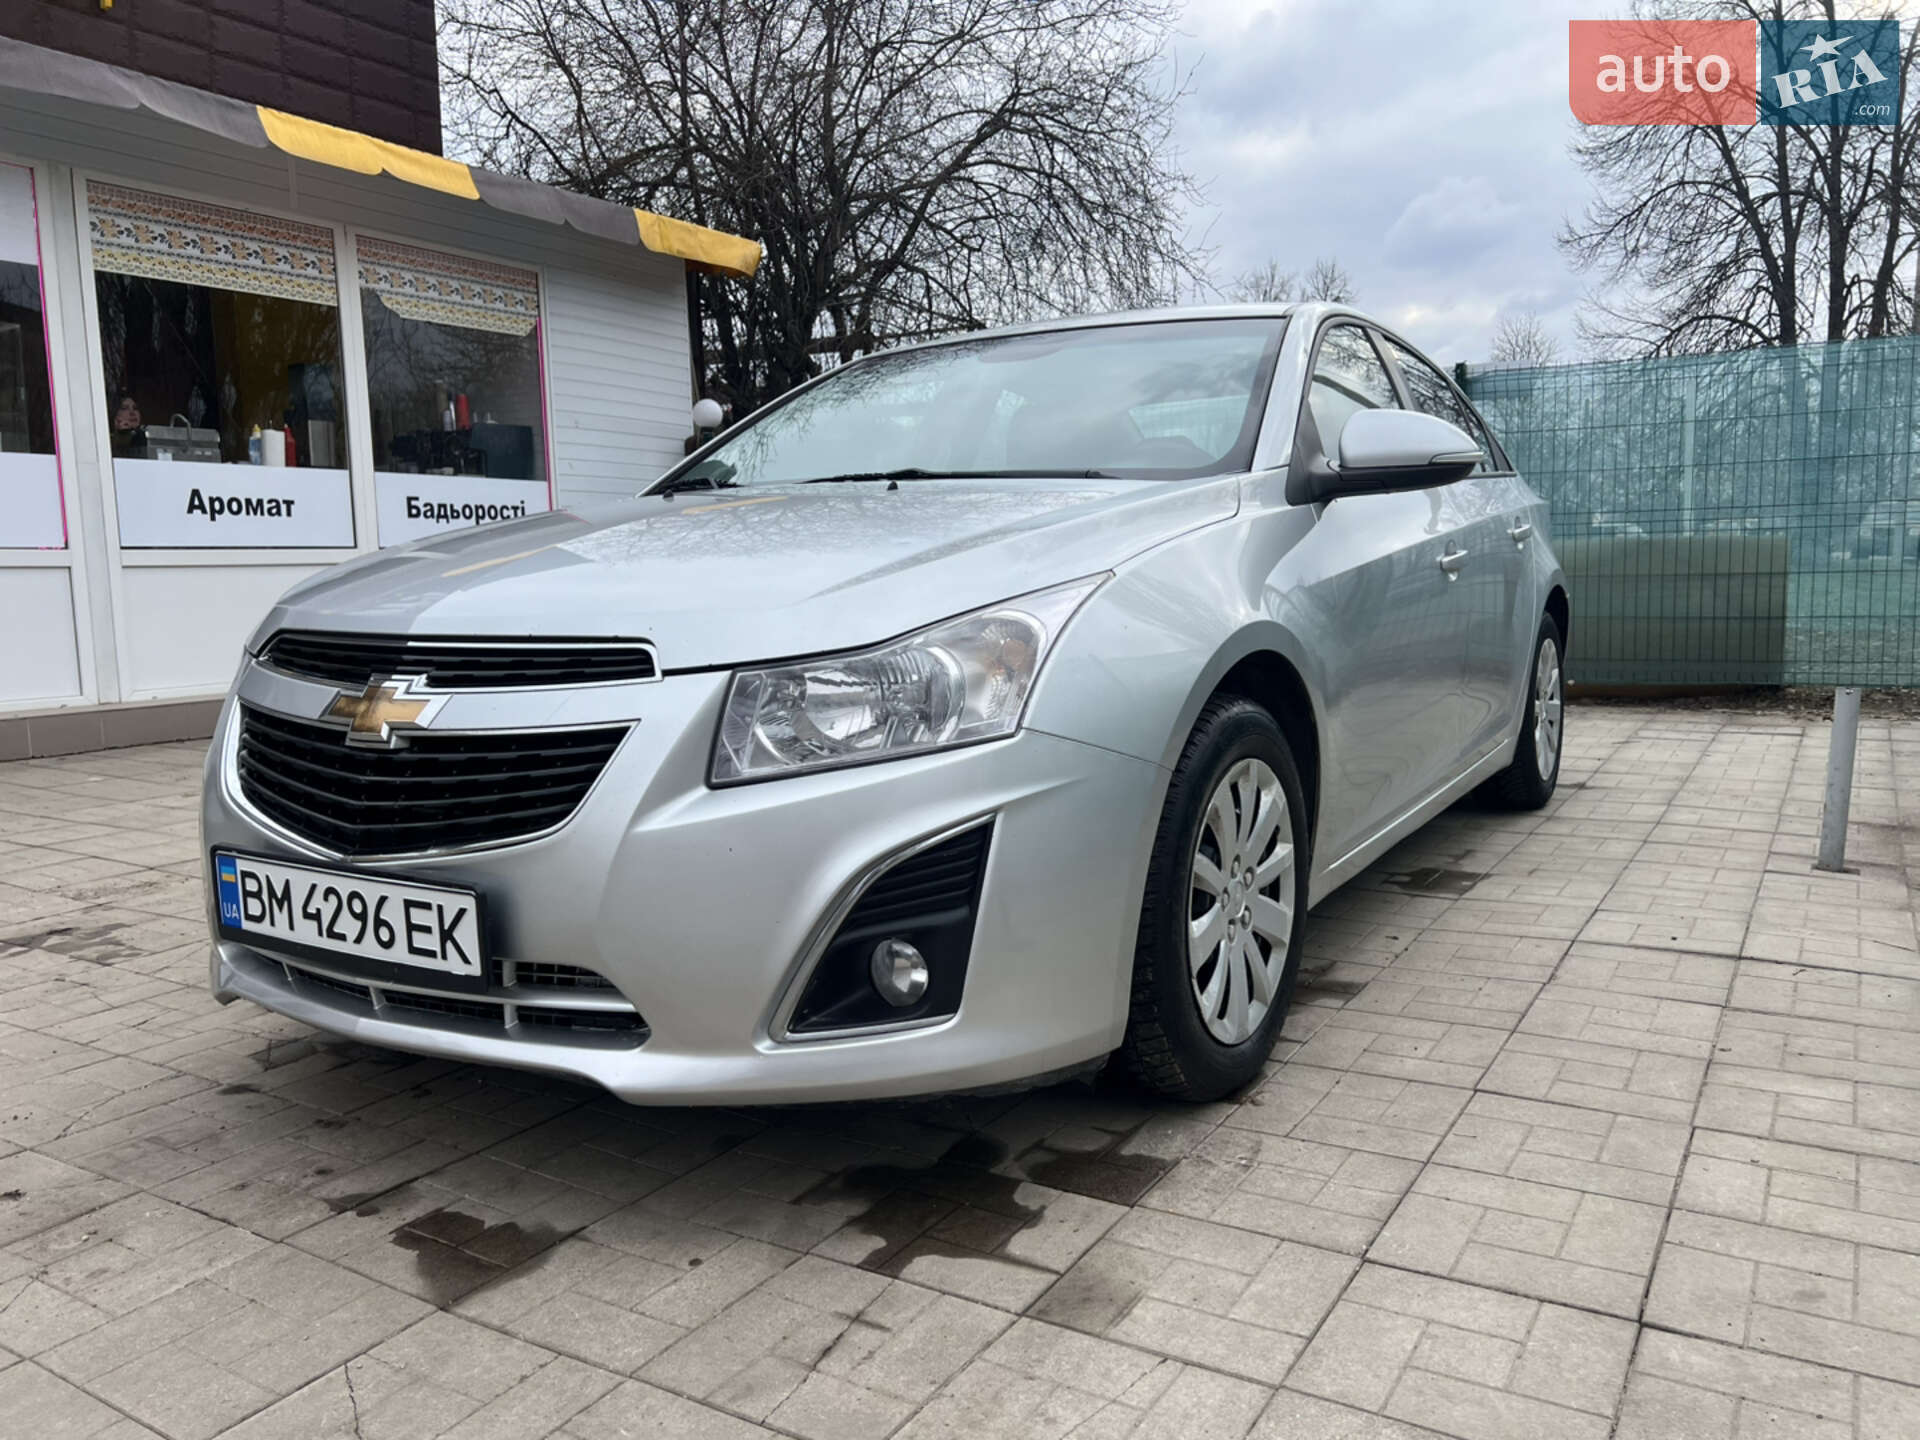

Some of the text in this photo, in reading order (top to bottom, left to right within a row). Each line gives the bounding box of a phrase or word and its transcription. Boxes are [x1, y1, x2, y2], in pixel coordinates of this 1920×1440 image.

[186, 488, 295, 521] Аромат
[406, 496, 526, 526] Бадьорості
[223, 902, 240, 919] UA
[240, 869, 473, 965] BM 4296 EK
